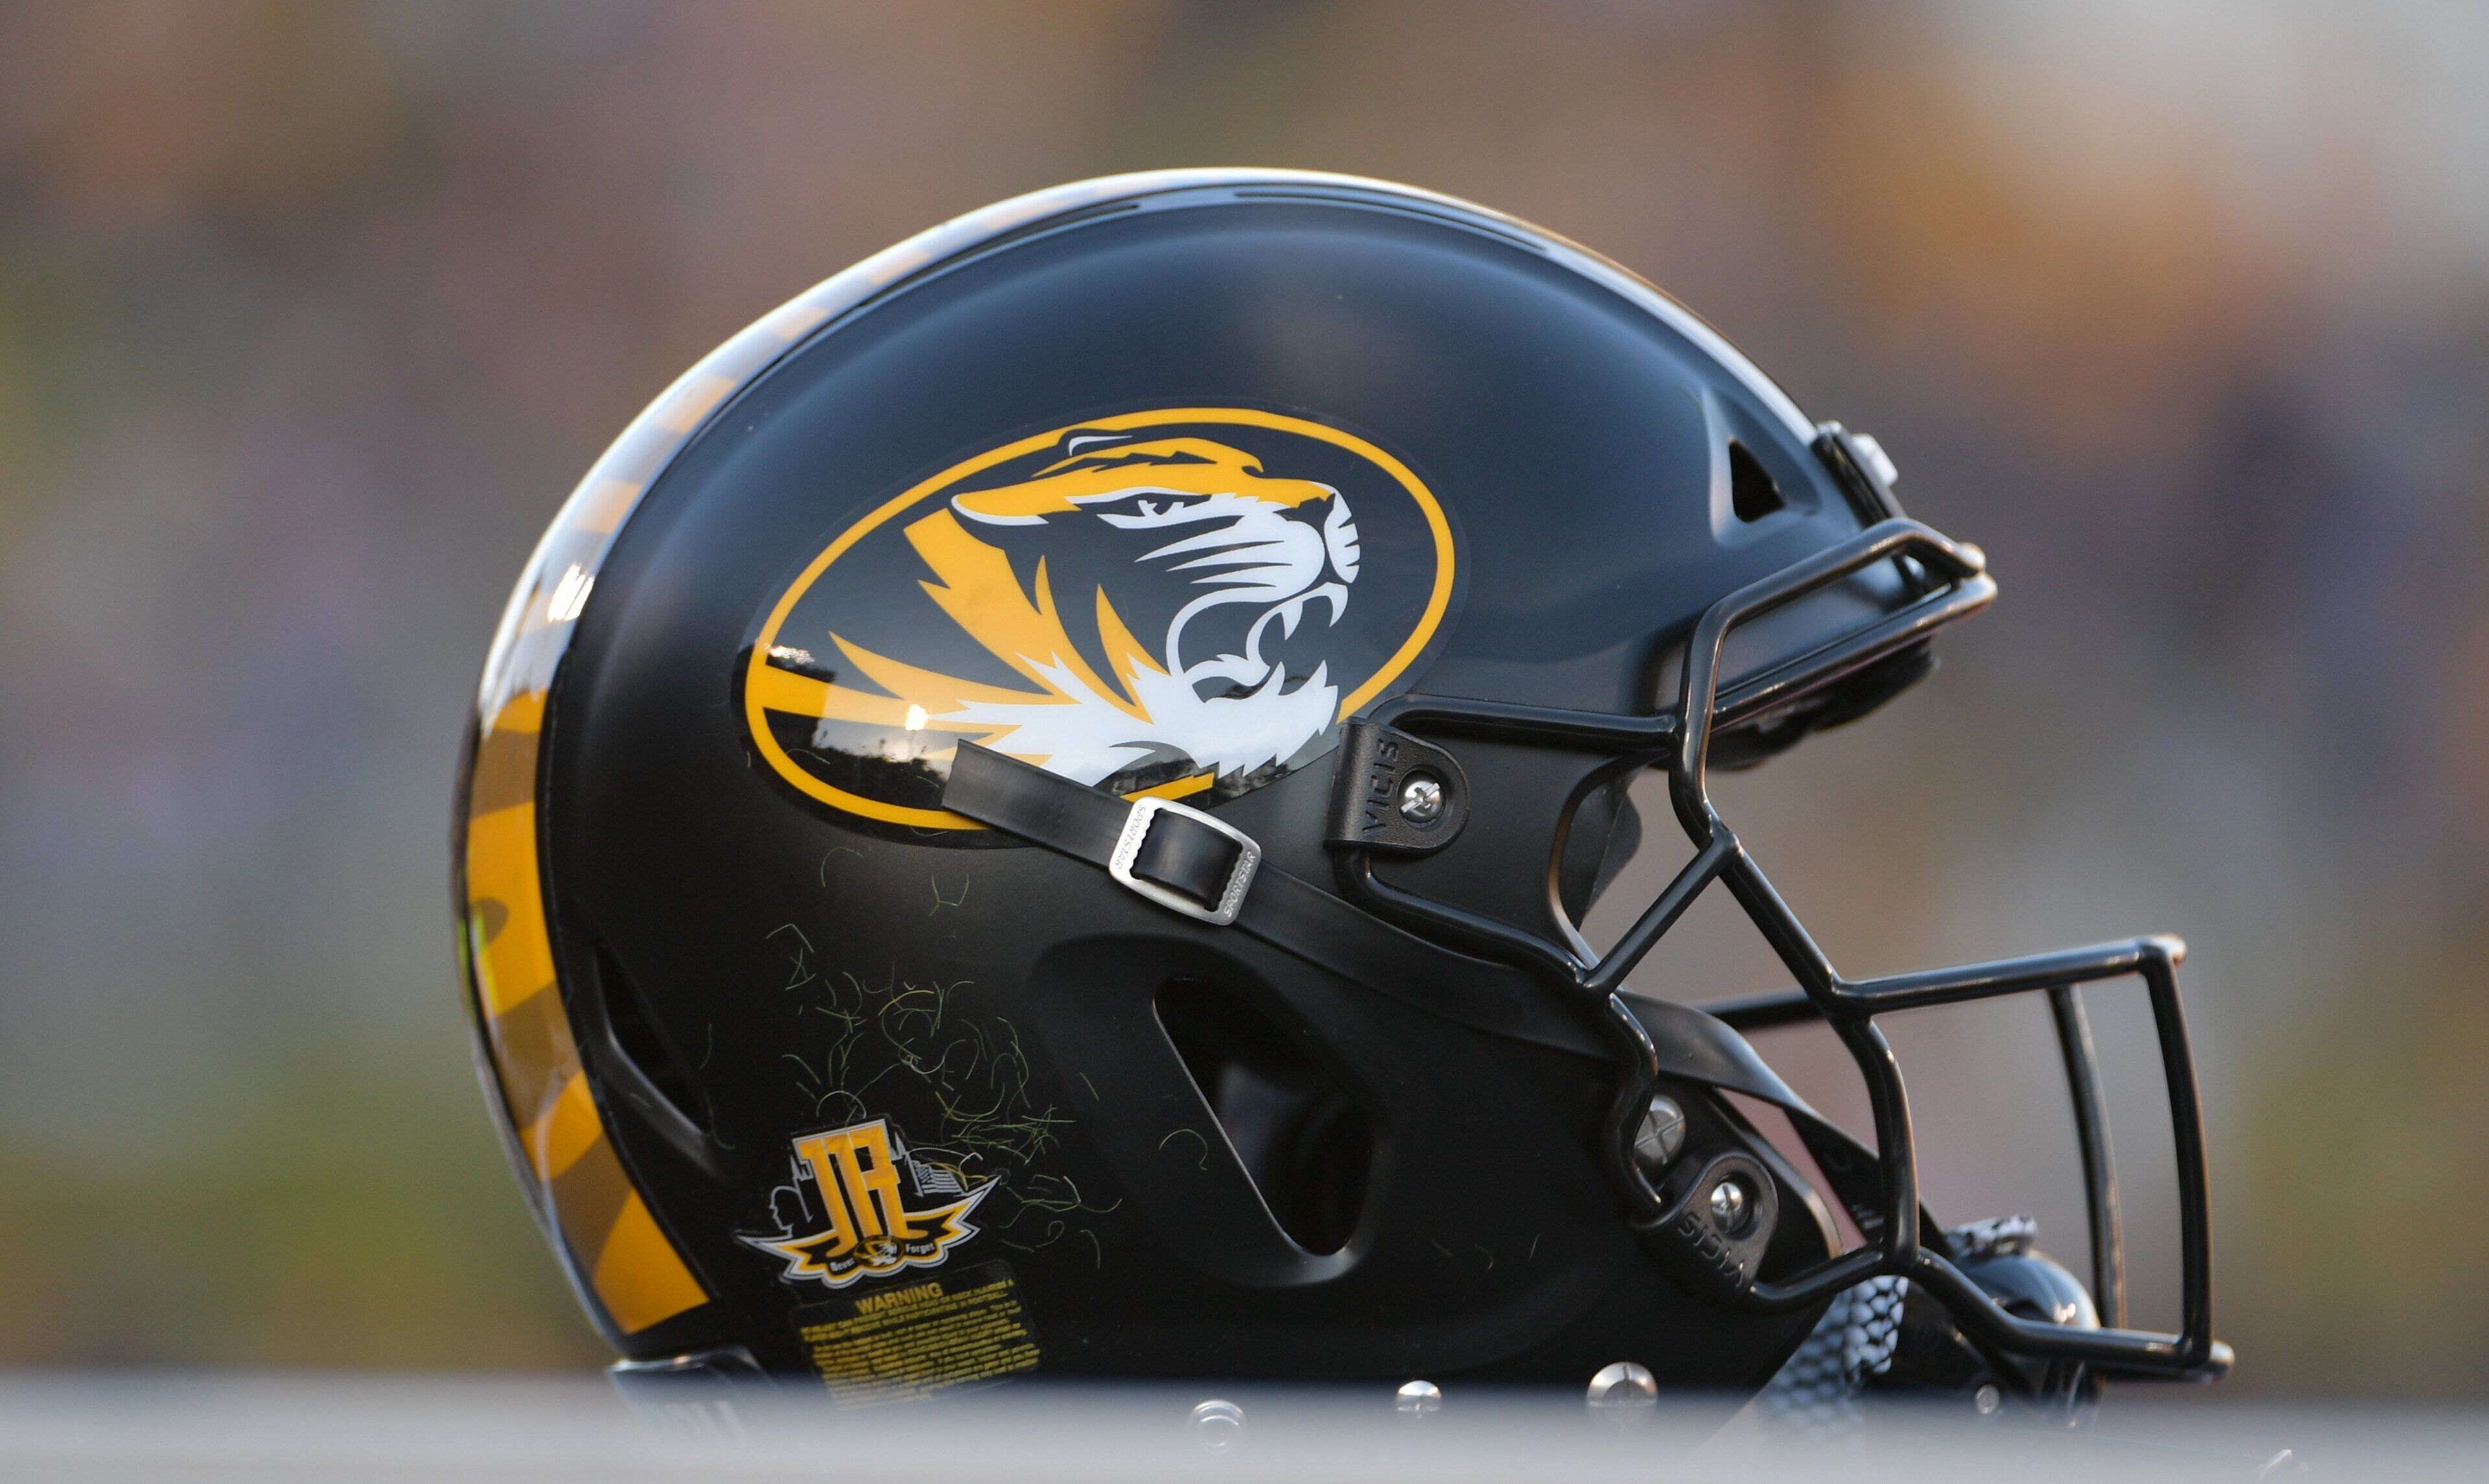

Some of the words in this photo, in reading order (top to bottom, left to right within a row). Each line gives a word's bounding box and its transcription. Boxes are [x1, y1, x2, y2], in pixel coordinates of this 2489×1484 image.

[1362, 738, 1399, 832] VICIS
[1116, 804, 1147, 869] SPORTSTAR
[1222, 851, 1256, 918] SPORTSTAR
[905, 1242, 935, 1256] Forget
[1677, 1212, 1744, 1287] VICIS
[855, 1282, 943, 1314] WARNING
